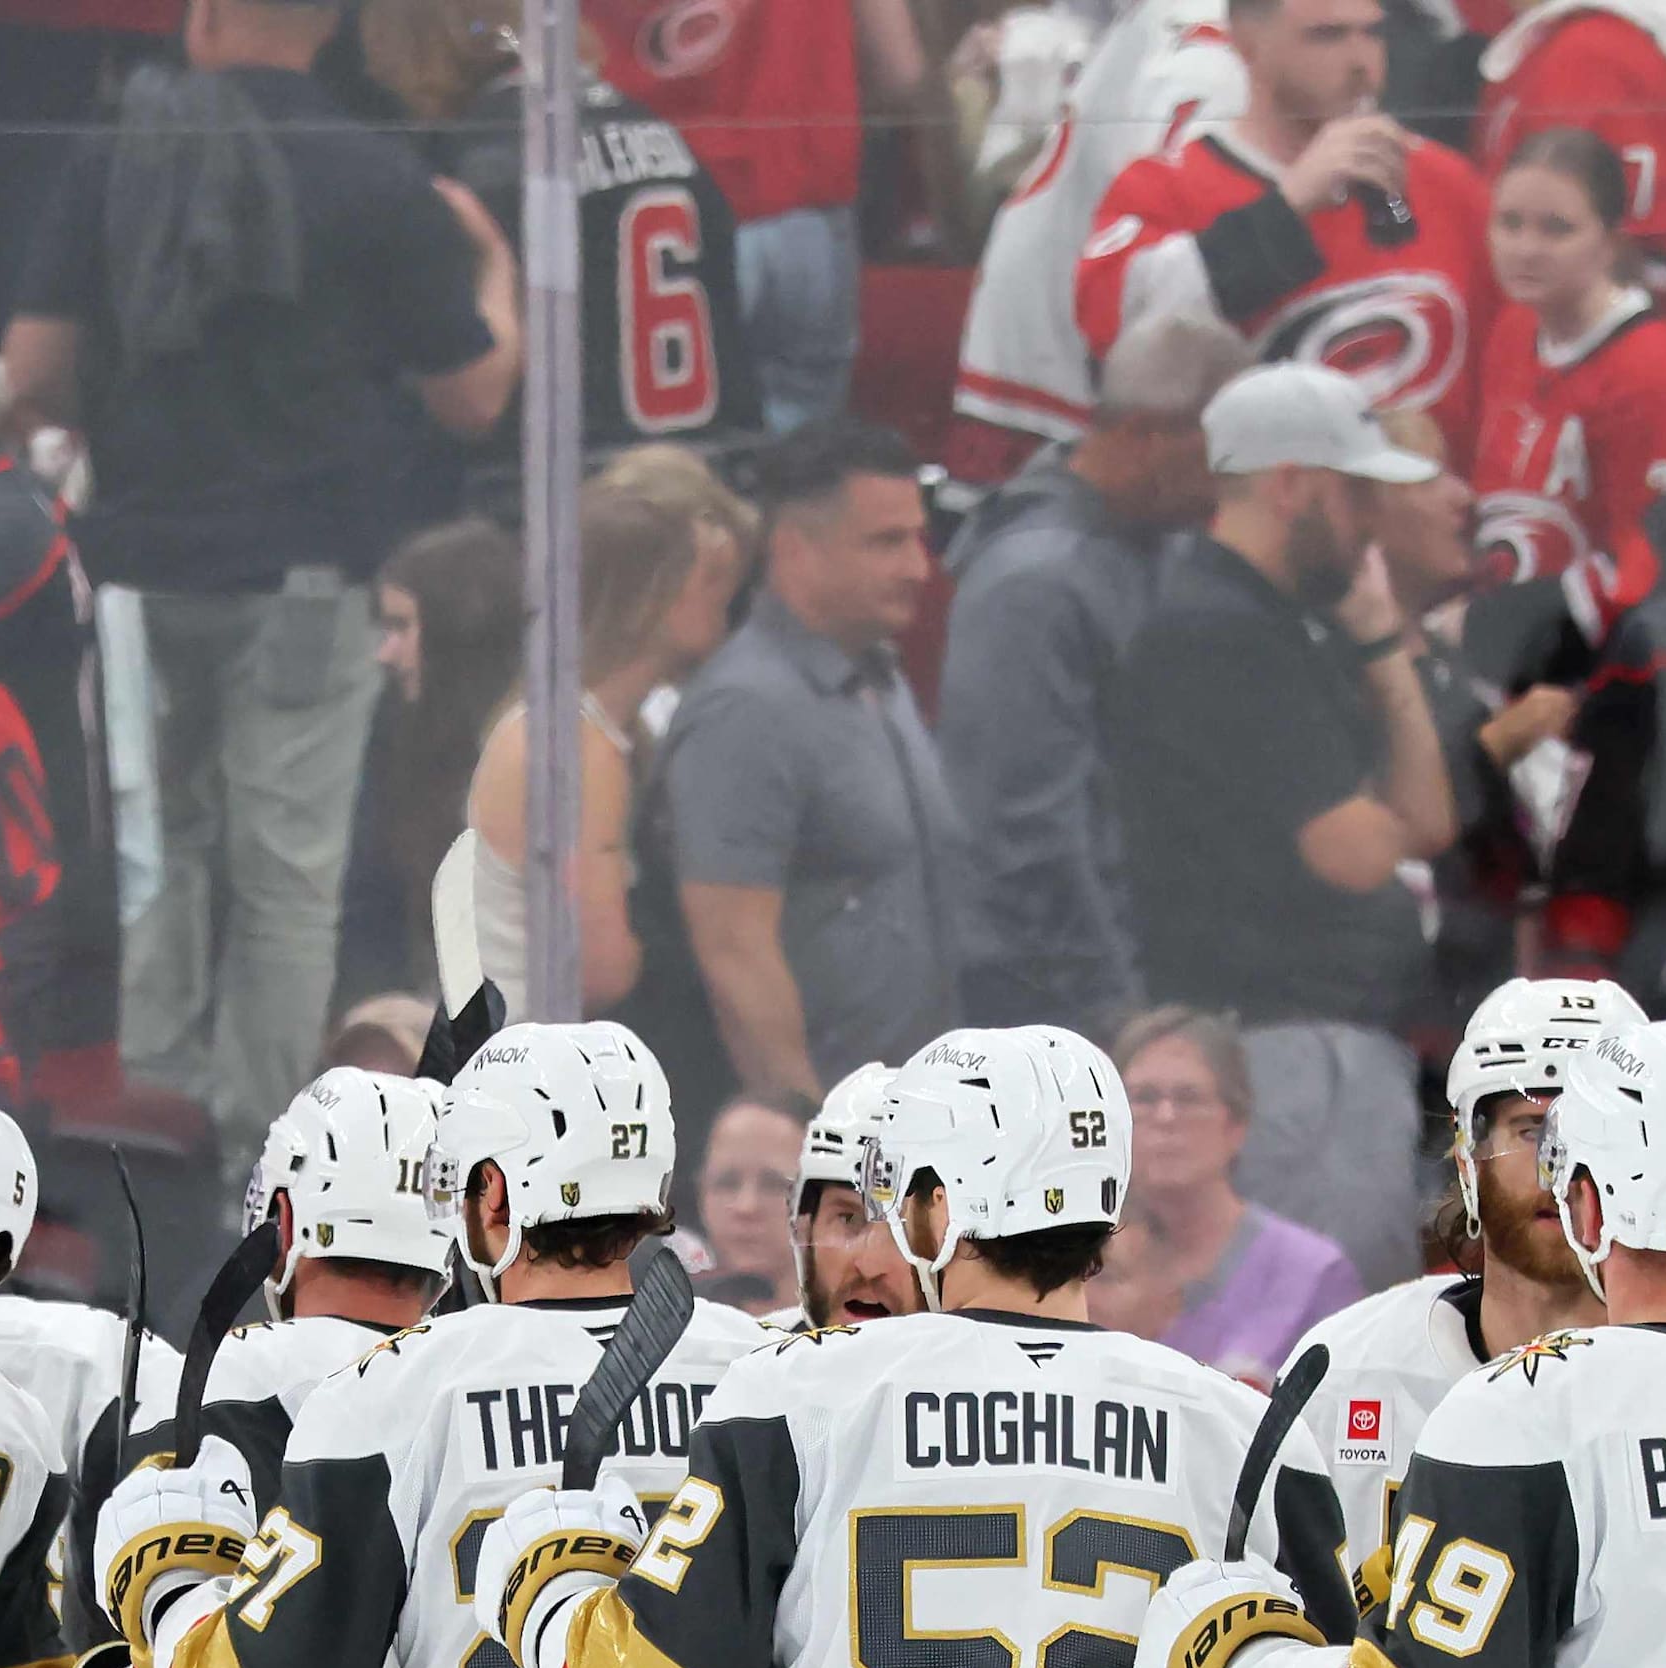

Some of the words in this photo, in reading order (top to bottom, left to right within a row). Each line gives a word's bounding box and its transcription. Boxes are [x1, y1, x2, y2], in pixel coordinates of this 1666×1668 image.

[618, 187, 717, 432] 6
[1541, 1035, 1589, 1050] CC
[610, 1122, 648, 1160] 27
[1069, 1111, 1108, 1149] 52
[12, 1170, 25, 1202] 5
[467, 1383, 717, 1471] THEDO
[904, 1392, 1169, 1485] COGHLAN
[1339, 1449, 1386, 1461] TOYOTA
